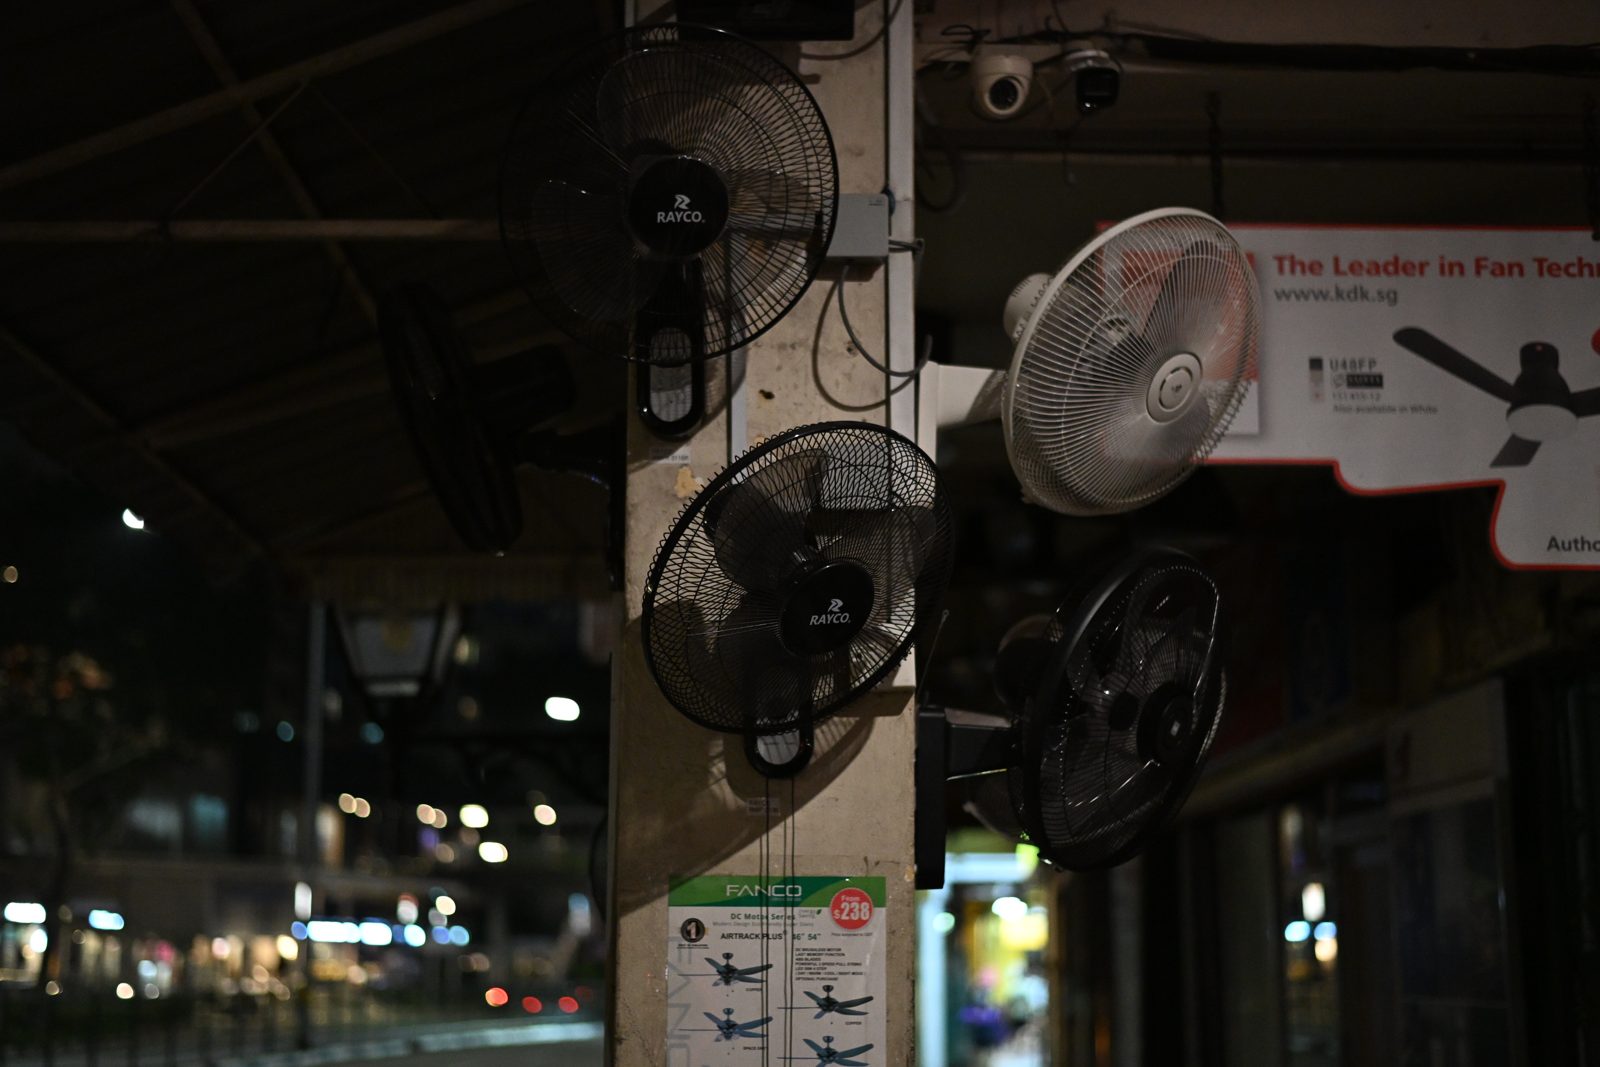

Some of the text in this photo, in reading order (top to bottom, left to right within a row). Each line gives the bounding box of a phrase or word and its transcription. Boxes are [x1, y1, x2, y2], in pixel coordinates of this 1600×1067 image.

[657, 211, 703, 223] RAYCO
[1273, 254, 1323, 276] The
[1333, 254, 1429, 276] Leader
[1439, 254, 1464, 277] in
[1475, 256, 1524, 277] Fan
[1274, 285, 1398, 306] www.kdk.sg
[809, 612, 850, 625] RAYCO
[726, 884, 802, 896] FANCO
[834, 902, 870, 920] $238
